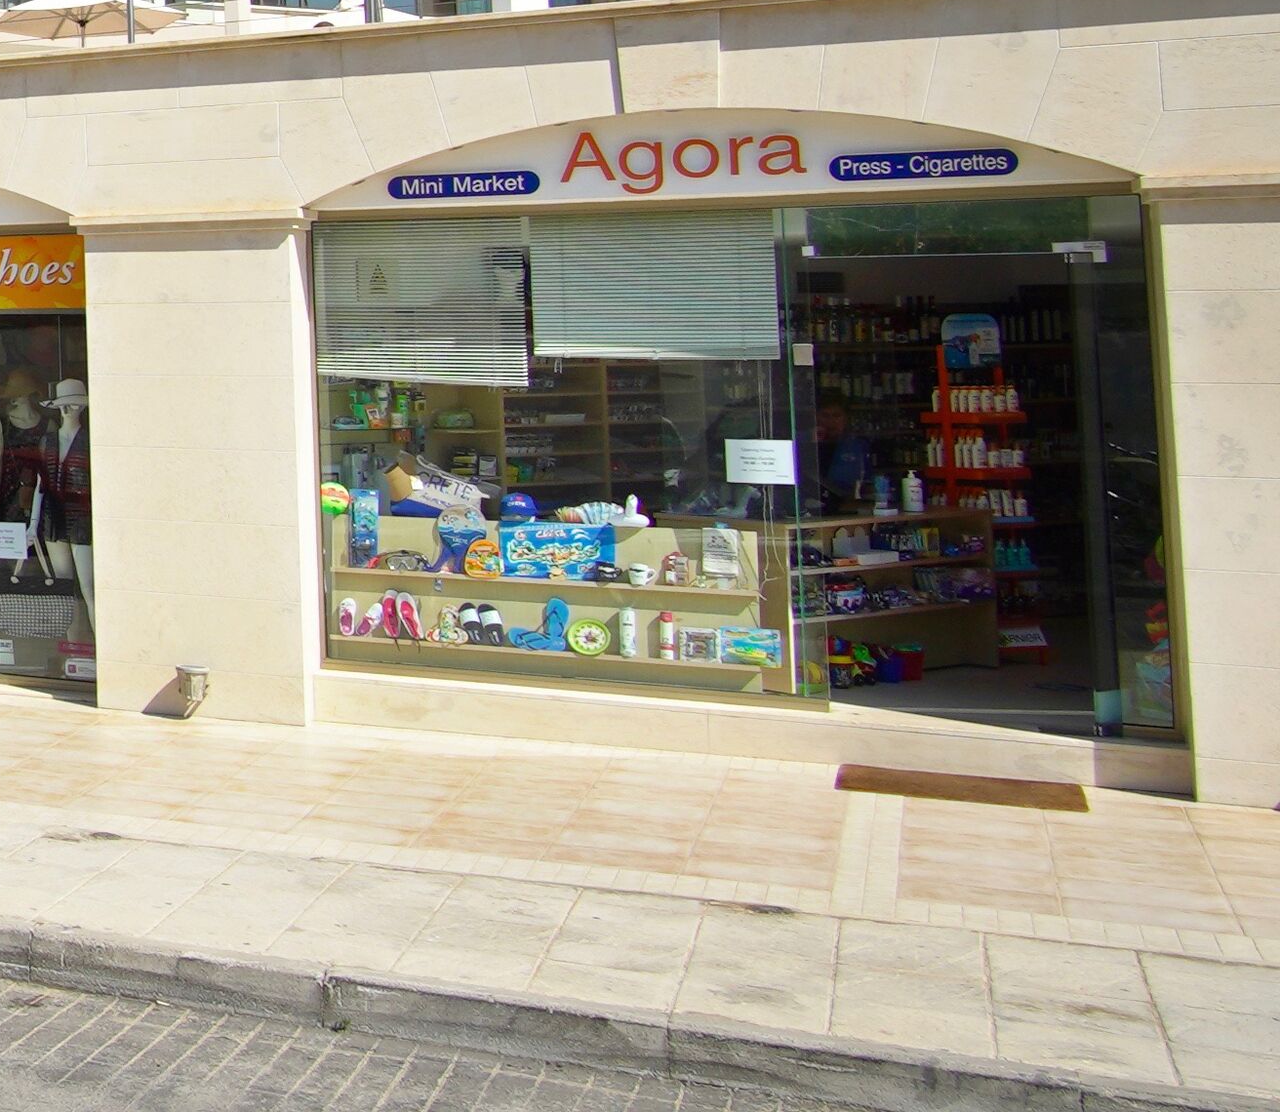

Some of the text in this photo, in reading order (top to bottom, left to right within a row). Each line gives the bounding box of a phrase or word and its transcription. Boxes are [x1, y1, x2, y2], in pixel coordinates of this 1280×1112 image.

[559, 131, 808, 195] Agora
[839, 159, 891, 176] Press
[909, 154, 1008, 177] Cigarettes
[401, 174, 525, 196] Mini Market
